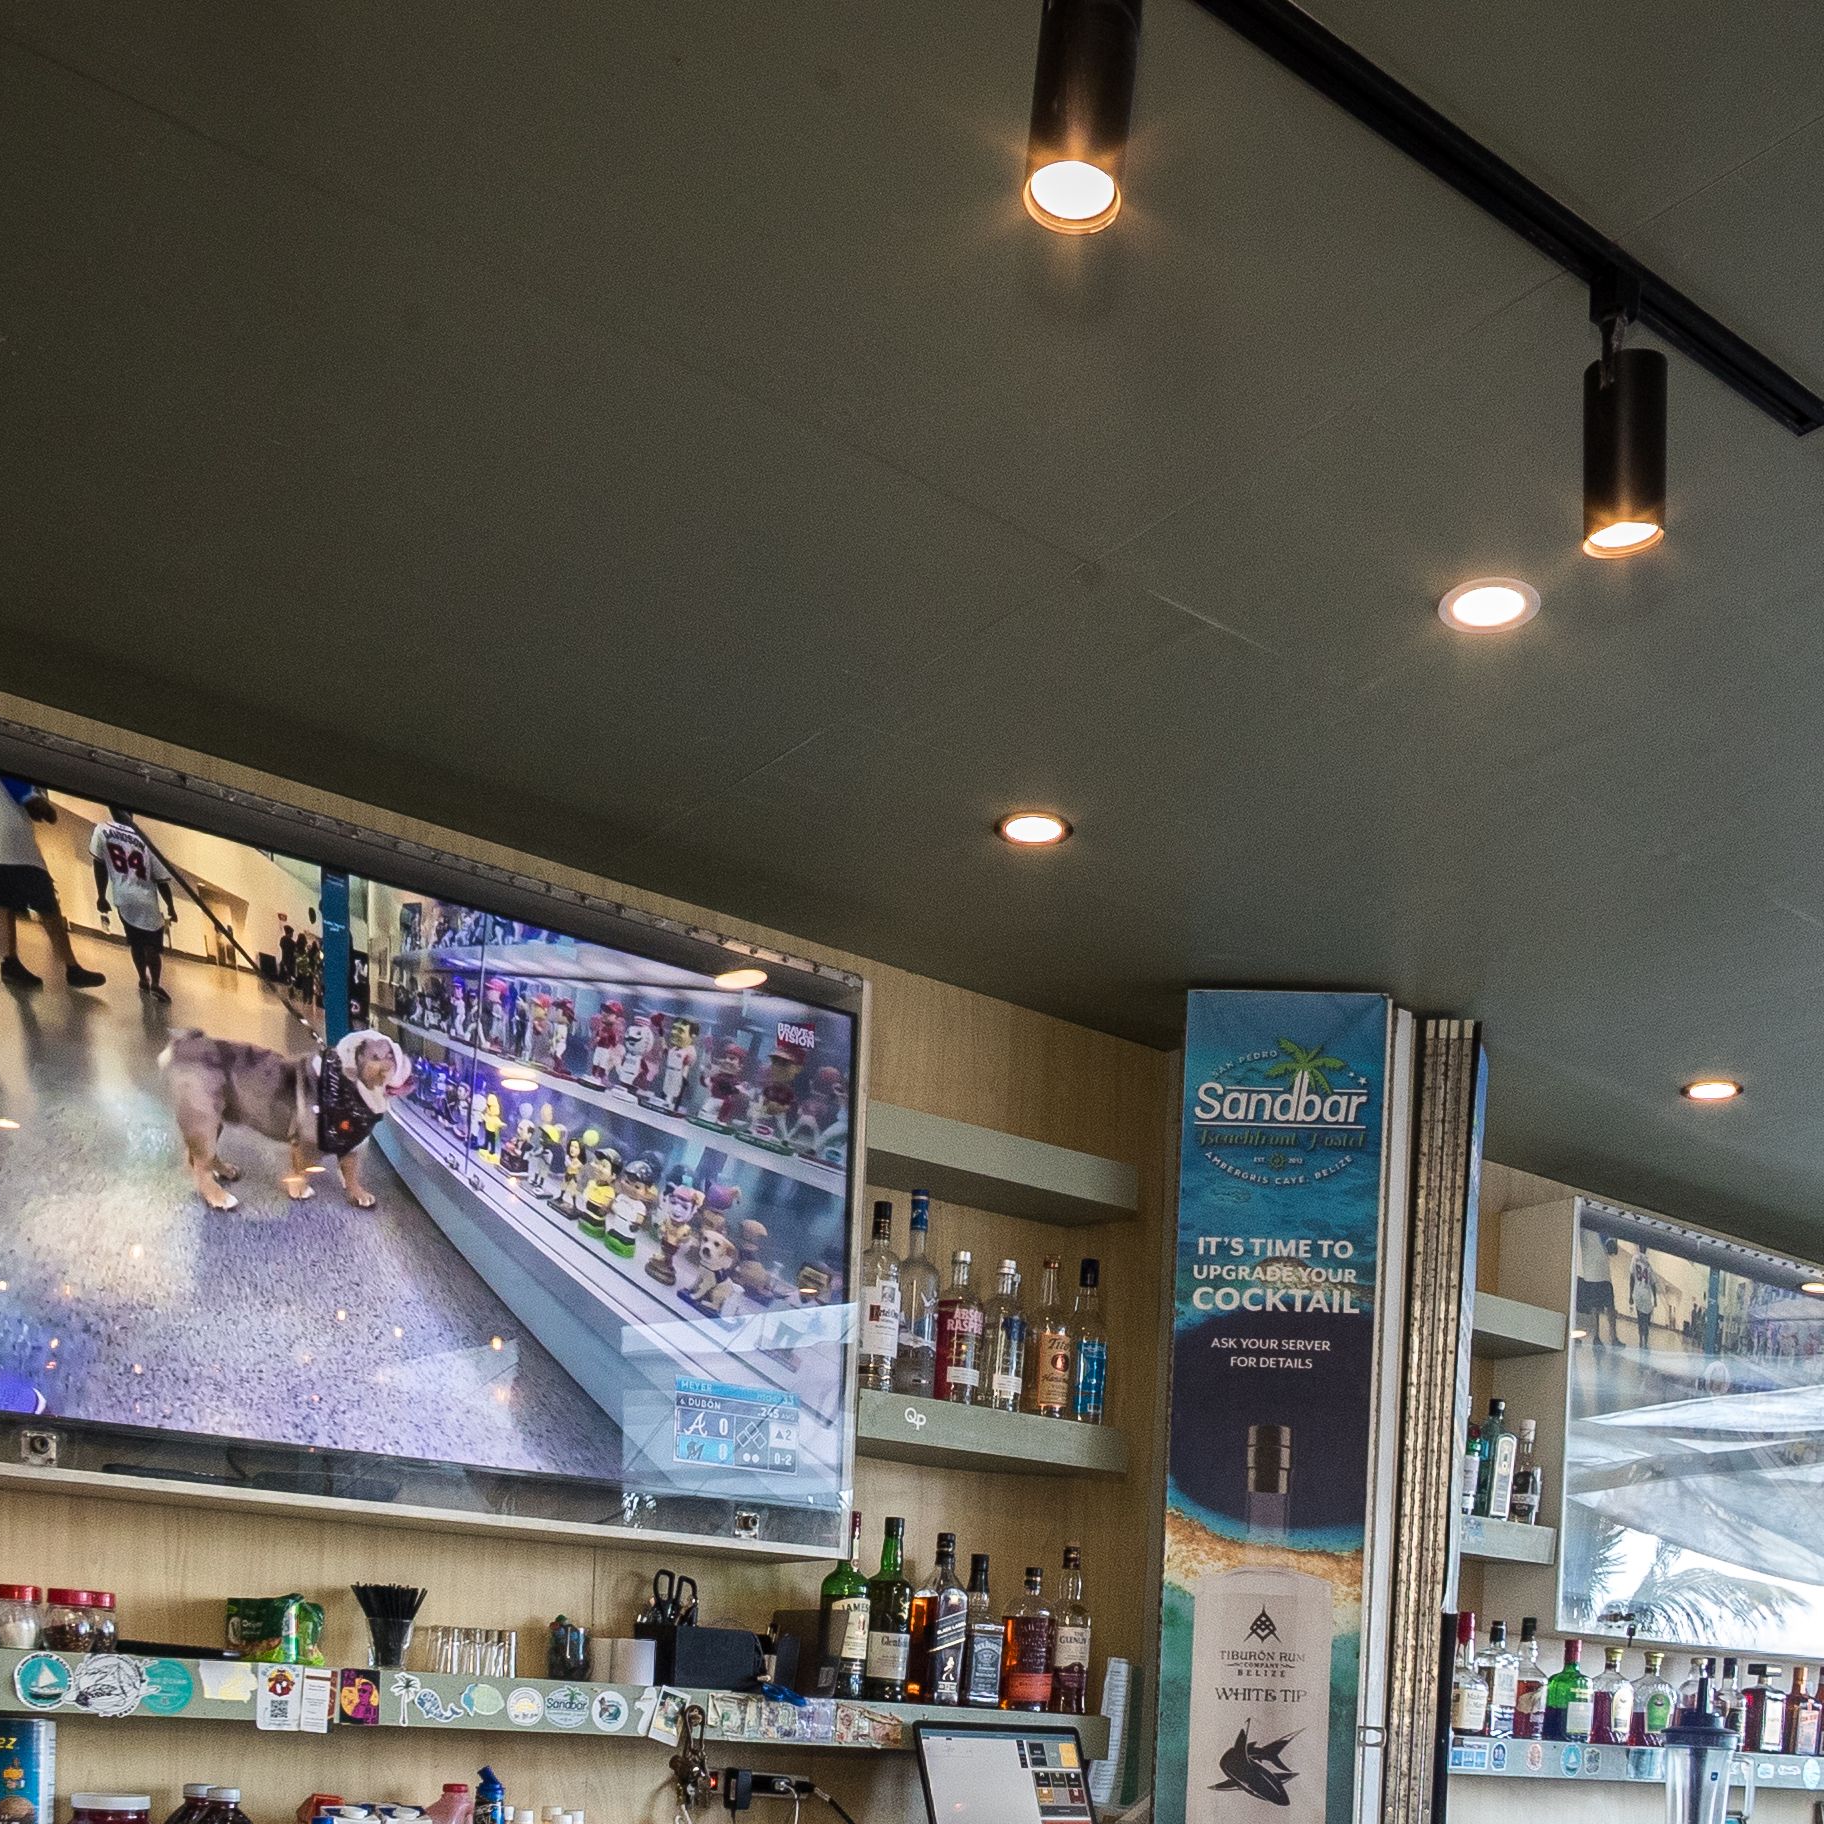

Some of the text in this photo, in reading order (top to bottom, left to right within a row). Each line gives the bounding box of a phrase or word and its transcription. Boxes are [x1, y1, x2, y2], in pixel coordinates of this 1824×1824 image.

[777, 1022, 815, 1038] BRAVES
[778, 1030, 815, 1049] VISION
[1212, 1050, 1278, 1078] SAN PEDRO
[1194, 1072, 1368, 1124] Sandbar
[1205, 1150, 1354, 1185] AMBERGRIS BELIZE
[1249, 1237, 1312, 1259] TIME
[1317, 1239, 1354, 1259] TO
[1192, 1264, 1358, 1284] UPGRADE YOUR
[1192, 1286, 1361, 1314] COCKTAIL
[1210, 1337, 1332, 1352] ASK YOUR SERVER
[1230, 1356, 1314, 1369] FOR DETAILS
[681, 1380, 712, 1392] MEYER
[688, 1396, 721, 1410] DUBÓN
[718, 1417, 729, 1436] 0
[1237, 1669, 1287, 1679] BELIZE
[546, 1696, 588, 1711] Sandbar
[1215, 1687, 1308, 1703] WHITE TIP
